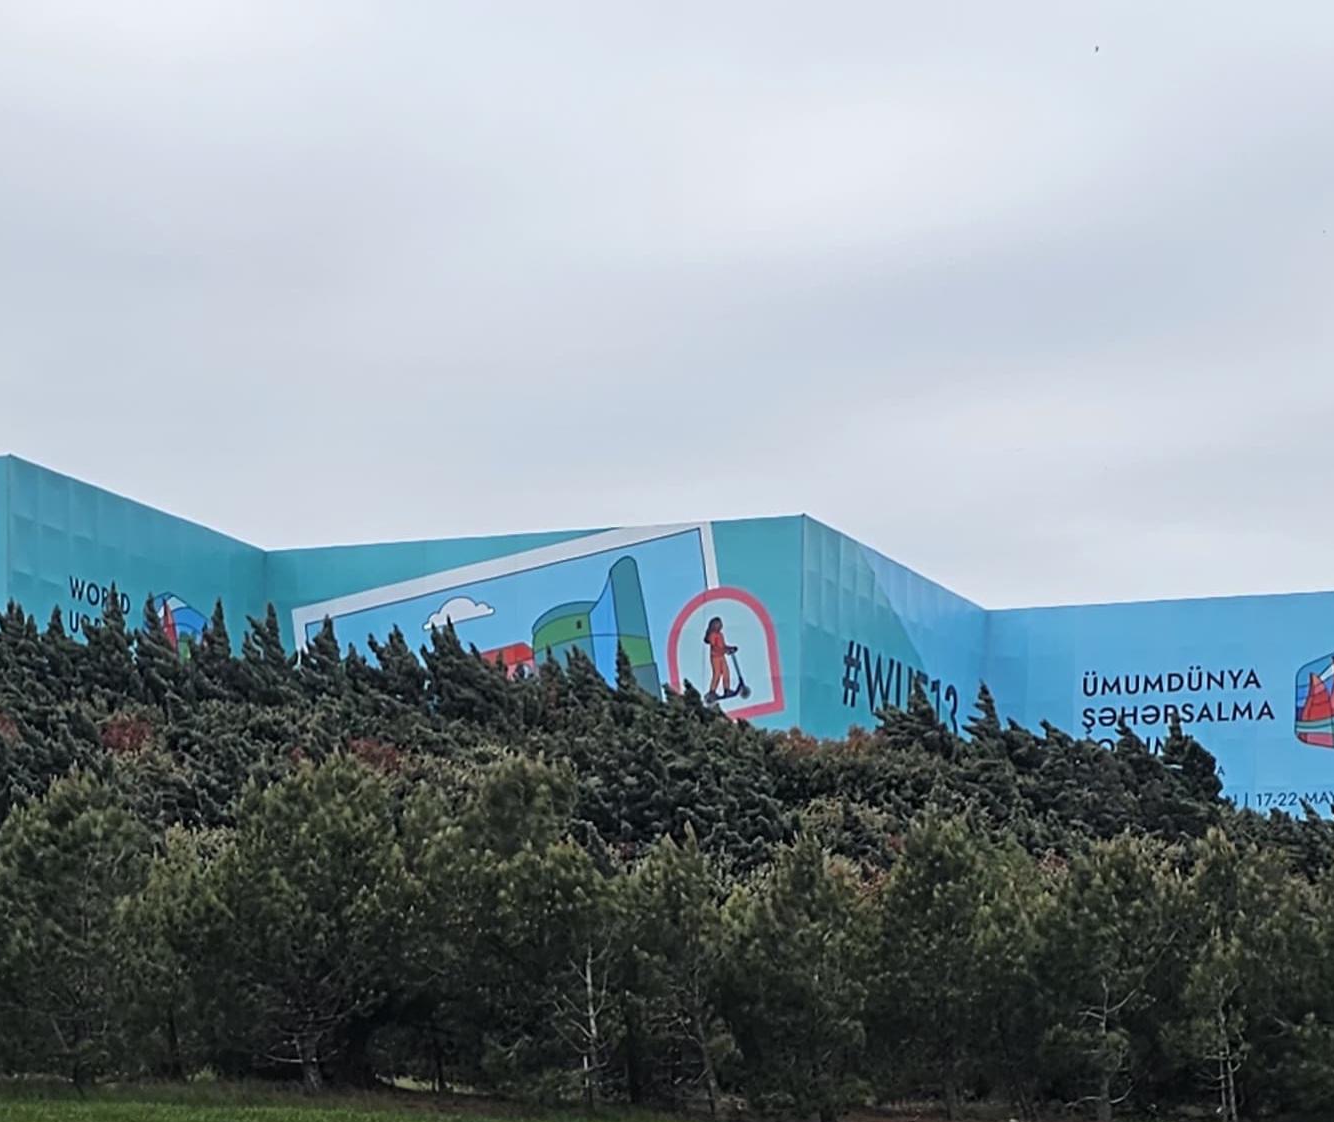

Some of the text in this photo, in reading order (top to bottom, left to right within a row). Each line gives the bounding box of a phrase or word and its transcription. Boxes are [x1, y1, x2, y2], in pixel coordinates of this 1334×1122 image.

[69, 576, 130, 614] WORD
[1083, 666, 1261, 696] ÜMUMDÜNYA
[1256, 792, 1298, 807] 17-22
